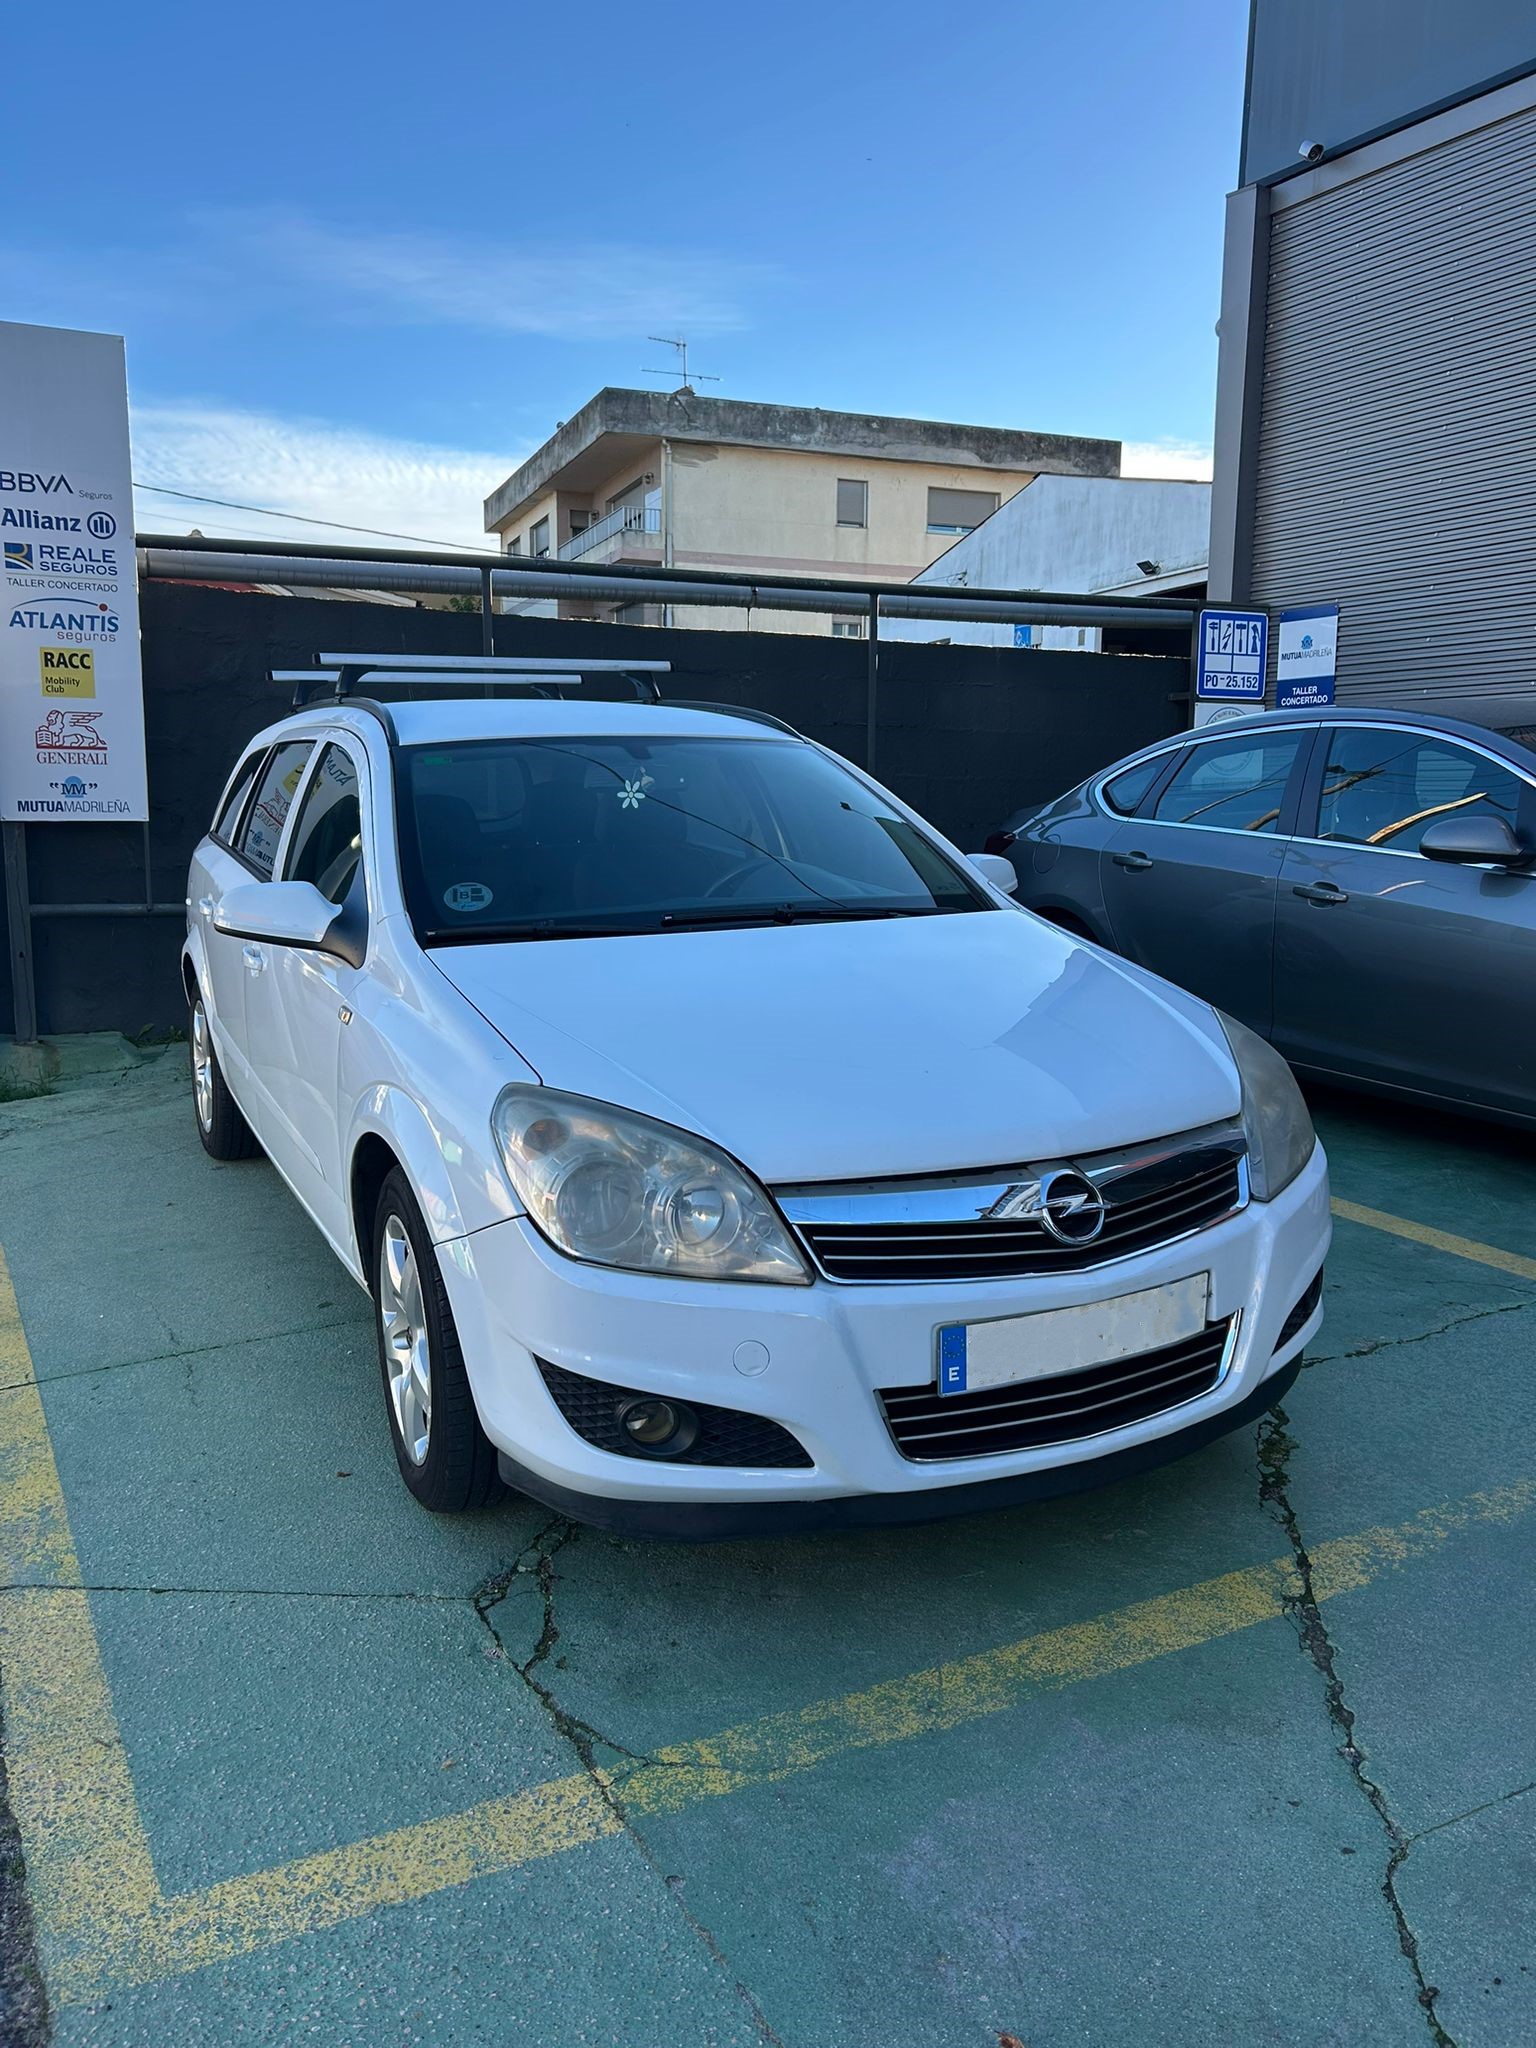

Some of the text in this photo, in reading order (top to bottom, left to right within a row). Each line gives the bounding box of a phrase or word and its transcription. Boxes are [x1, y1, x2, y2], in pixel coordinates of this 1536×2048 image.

[0, 471, 112, 500] BBVA Seguros
[1, 508, 81, 532] Allianz
[39, 544, 116, 563] REALE
[40, 562, 117, 576] SEGUROS
[6, 577, 118, 592] TALLER CONCERTADO
[9, 610, 119, 632] ATLANTIS
[57, 631, 116, 643] seguros
[43, 652, 91, 669] RACC
[45, 677, 80, 687] Mobility
[45, 685, 65, 694] Club
[1292, 686, 1318, 696] TALLER
[1281, 695, 1328, 706] CONCERTADO
[37, 752, 108, 766] GENERALI
[18, 799, 131, 813] MUTUAMADRILEÑA
[949, 1366, 959, 1381] E
